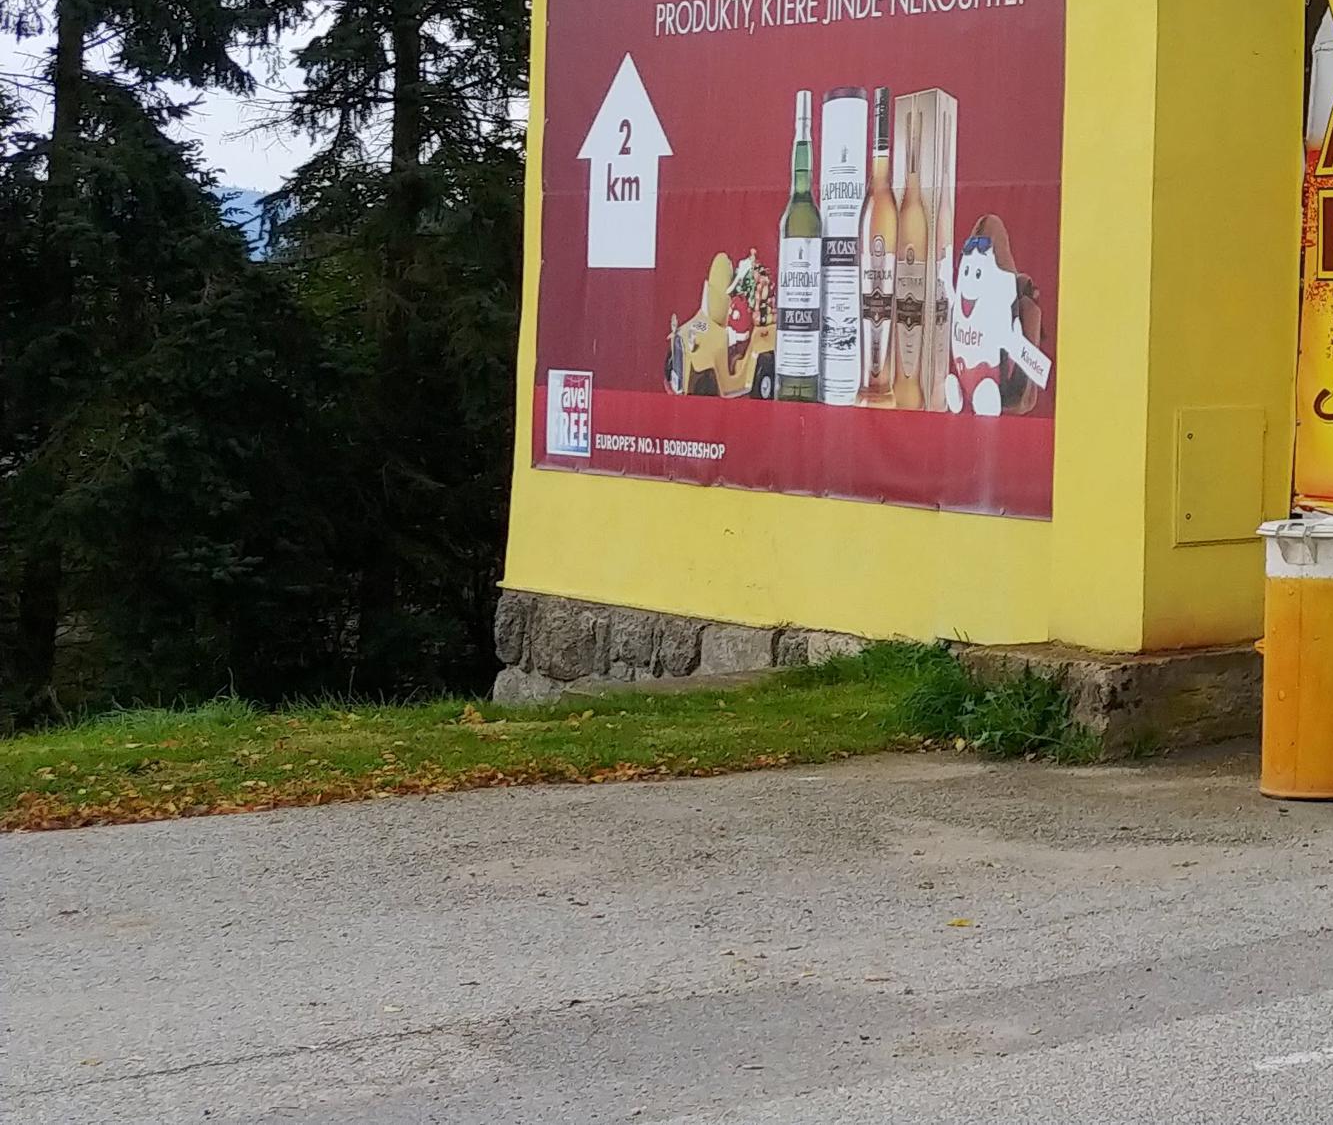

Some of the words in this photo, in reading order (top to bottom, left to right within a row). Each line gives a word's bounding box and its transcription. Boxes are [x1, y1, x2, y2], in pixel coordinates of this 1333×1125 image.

[618, 119, 631, 155] 2
[606, 163, 640, 201] km
[595, 433, 636, 452] EUROPE'S
[664, 439, 726, 461] BORDERSHOP
